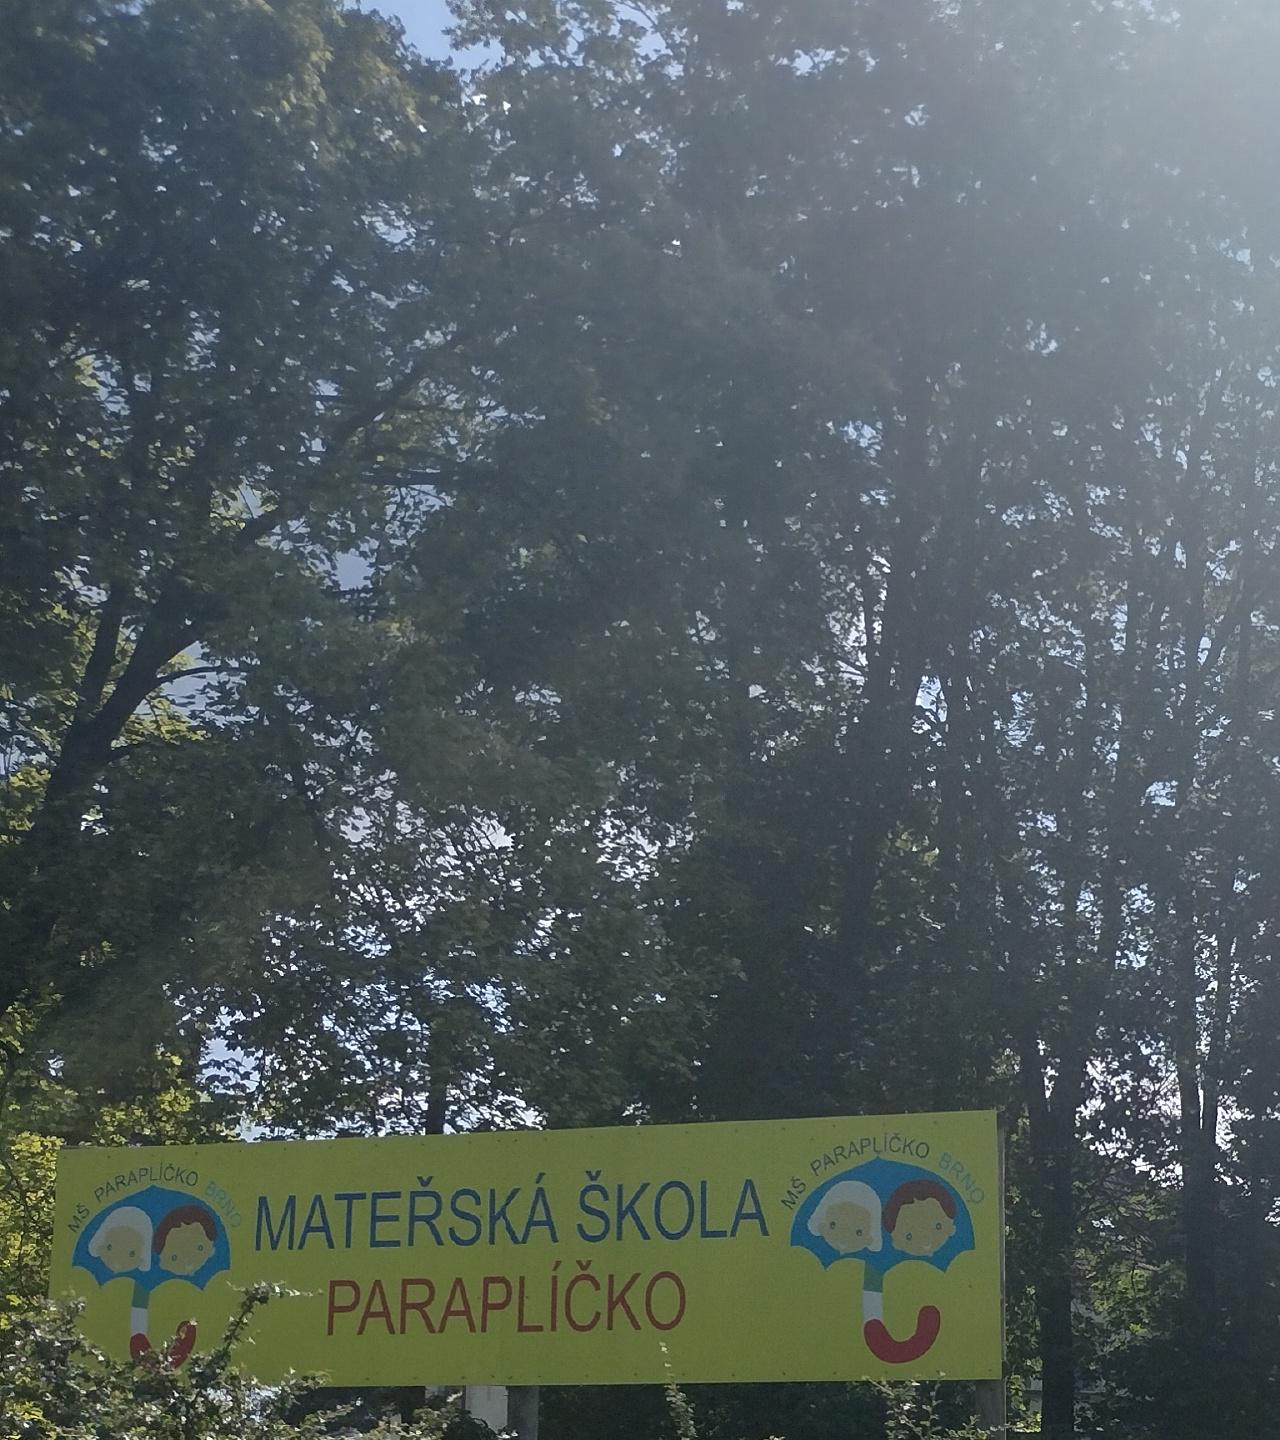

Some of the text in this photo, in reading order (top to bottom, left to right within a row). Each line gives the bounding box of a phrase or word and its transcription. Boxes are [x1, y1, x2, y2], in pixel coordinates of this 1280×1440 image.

[68, 1161, 242, 1233] MŠ PARAPLÍČKO BRNO
[781, 1132, 985, 1210] MŠ PARAPLÍČKO BRNO
[255, 1170, 770, 1251] MATEŘSKÁ ŠKOLA
[327, 1260, 686, 1335] PARAPLÍČKO
